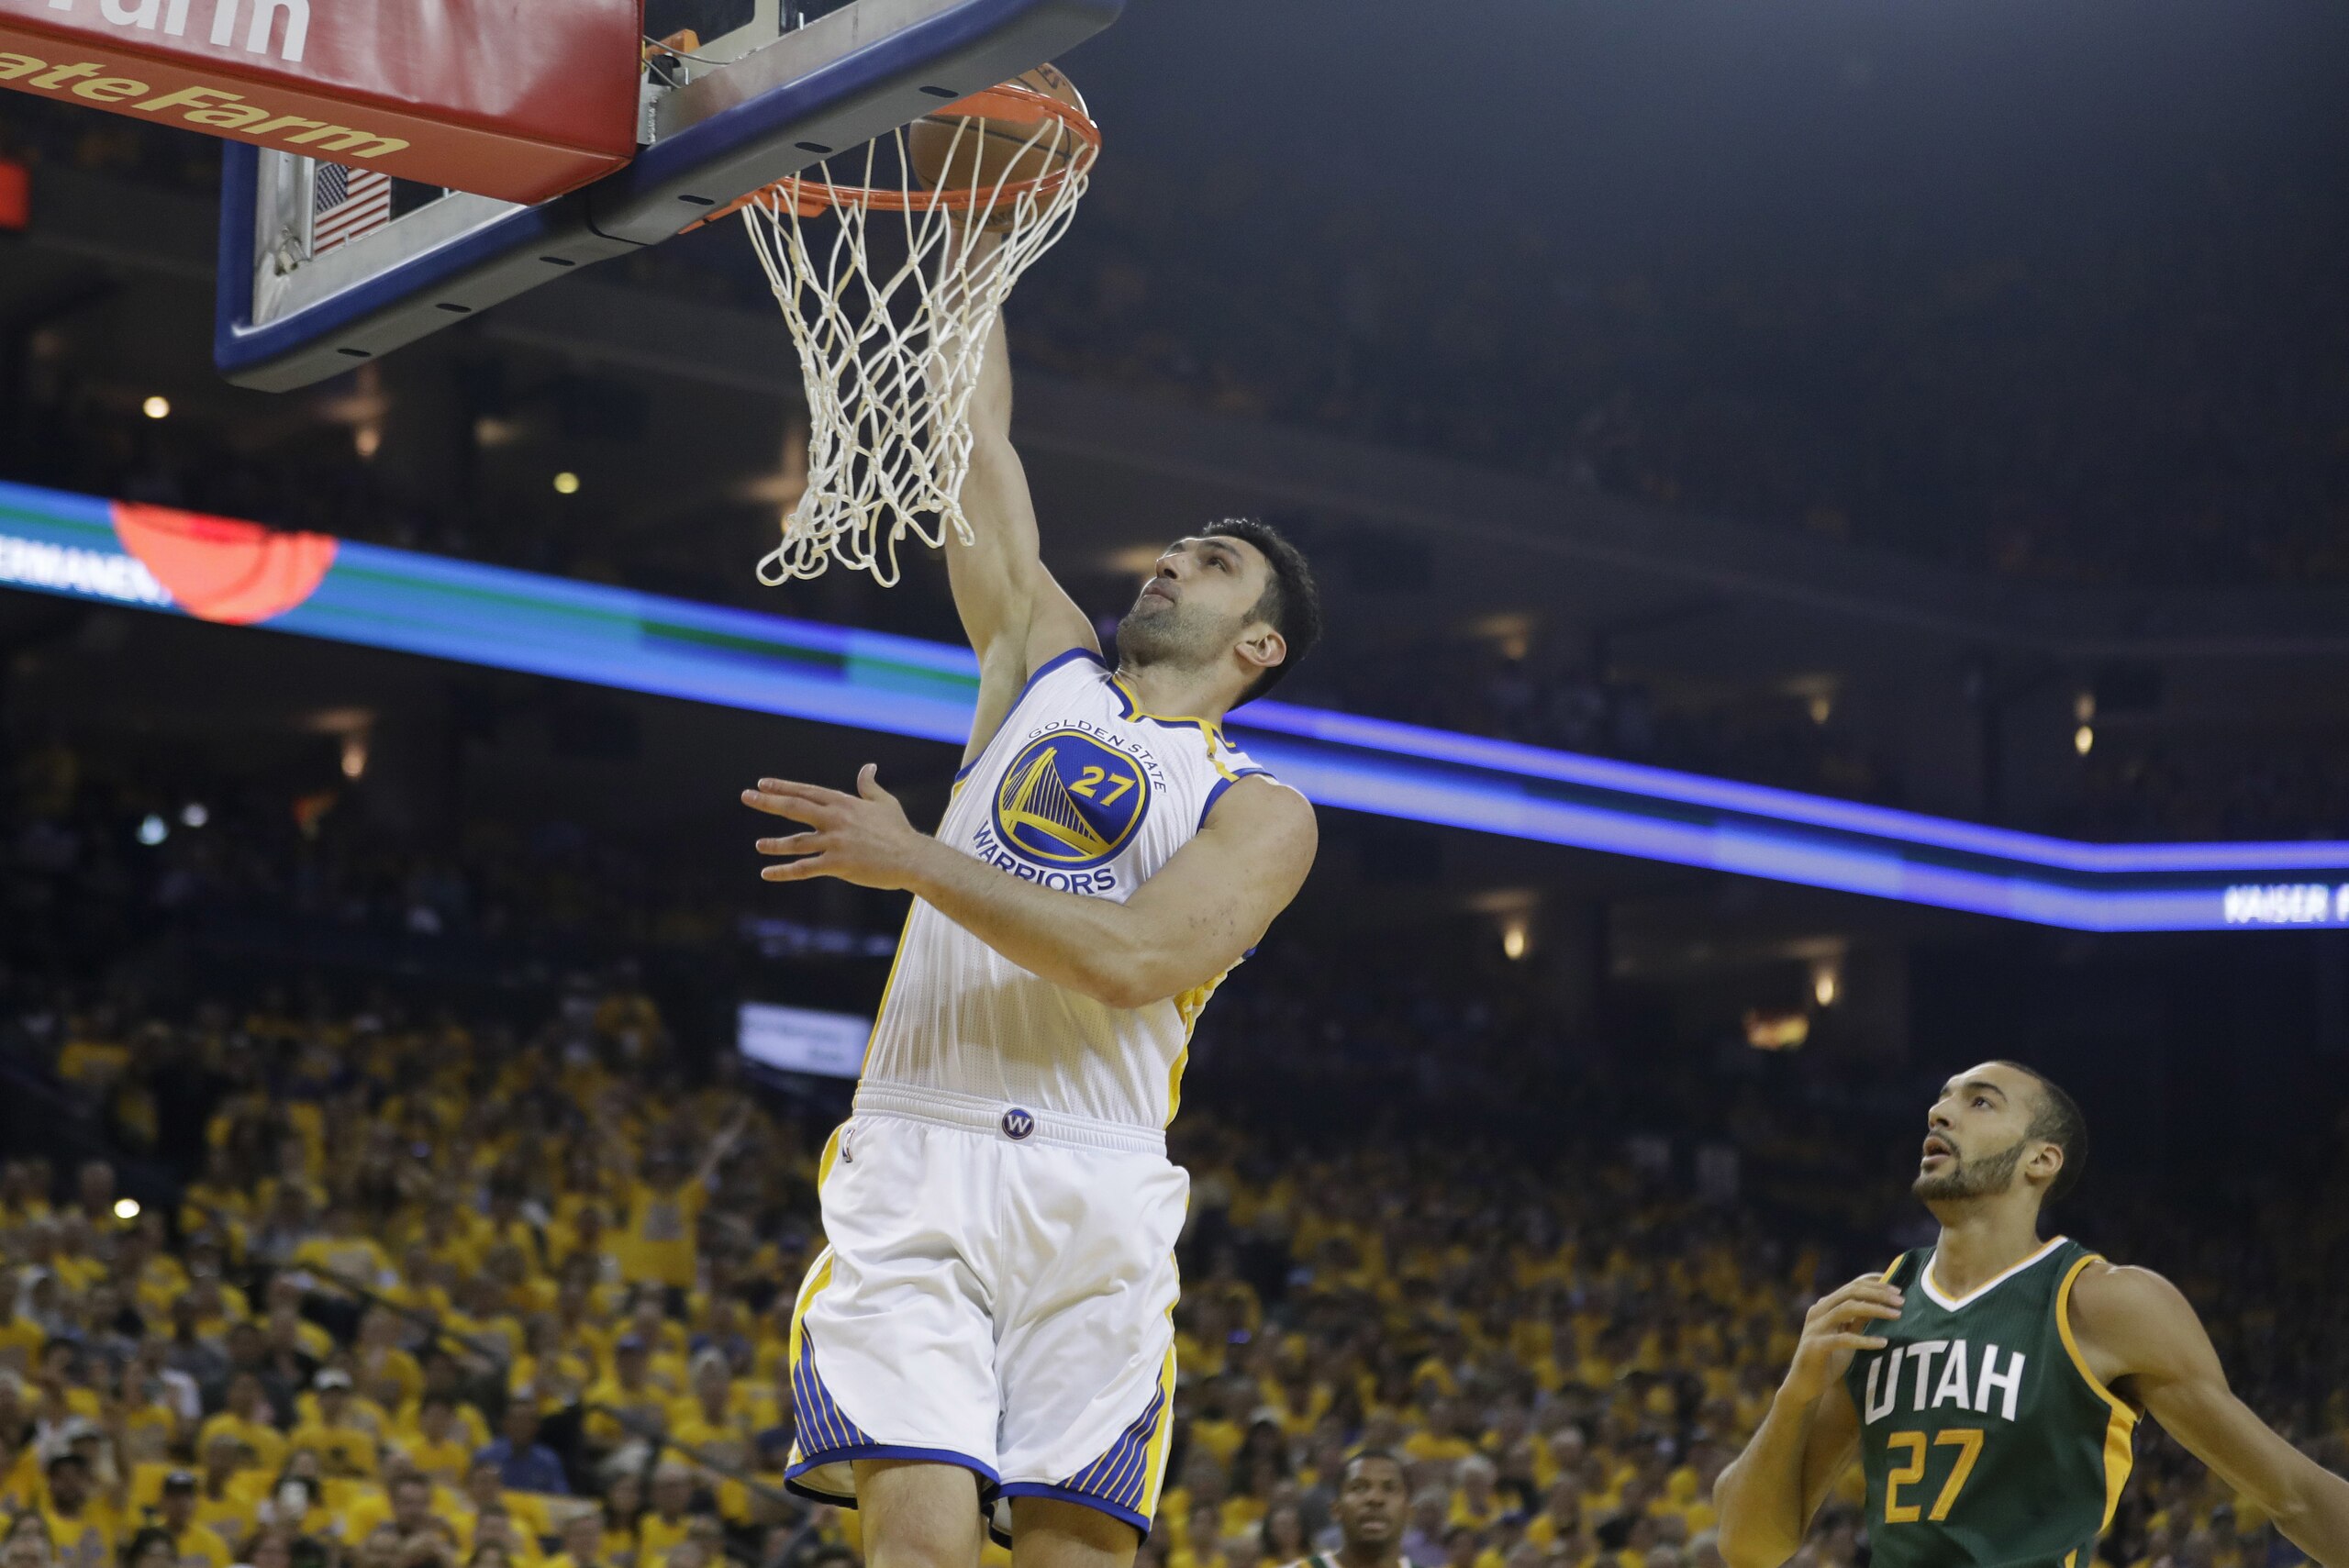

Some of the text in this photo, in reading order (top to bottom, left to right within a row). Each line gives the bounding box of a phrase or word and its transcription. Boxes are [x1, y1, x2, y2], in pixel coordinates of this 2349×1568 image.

[1028, 718, 1167, 794] GOLDEN STATE
[1068, 766, 1136, 806] 27
[973, 820, 1117, 895] WARRIORS
[1865, 1340, 2026, 1425] UTAH
[1885, 1429, 1985, 1524] 27
